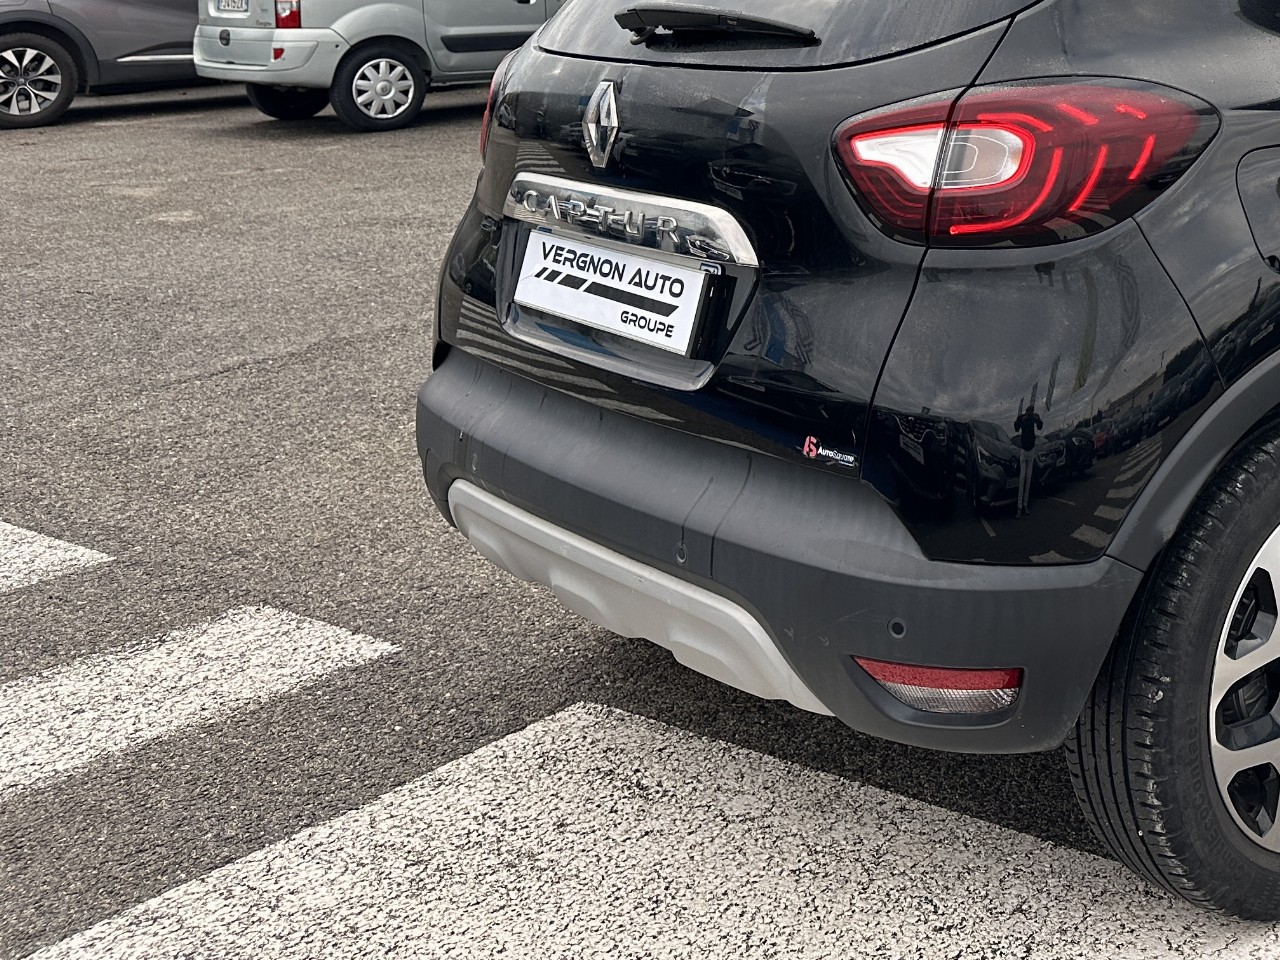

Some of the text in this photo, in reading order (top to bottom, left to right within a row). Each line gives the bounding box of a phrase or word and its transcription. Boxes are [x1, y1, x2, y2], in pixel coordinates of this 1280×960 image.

[523, 190, 682, 243] CAPTUR
[542, 241, 685, 299] VERGNON AUTO
[620, 310, 675, 338] GROUPE
